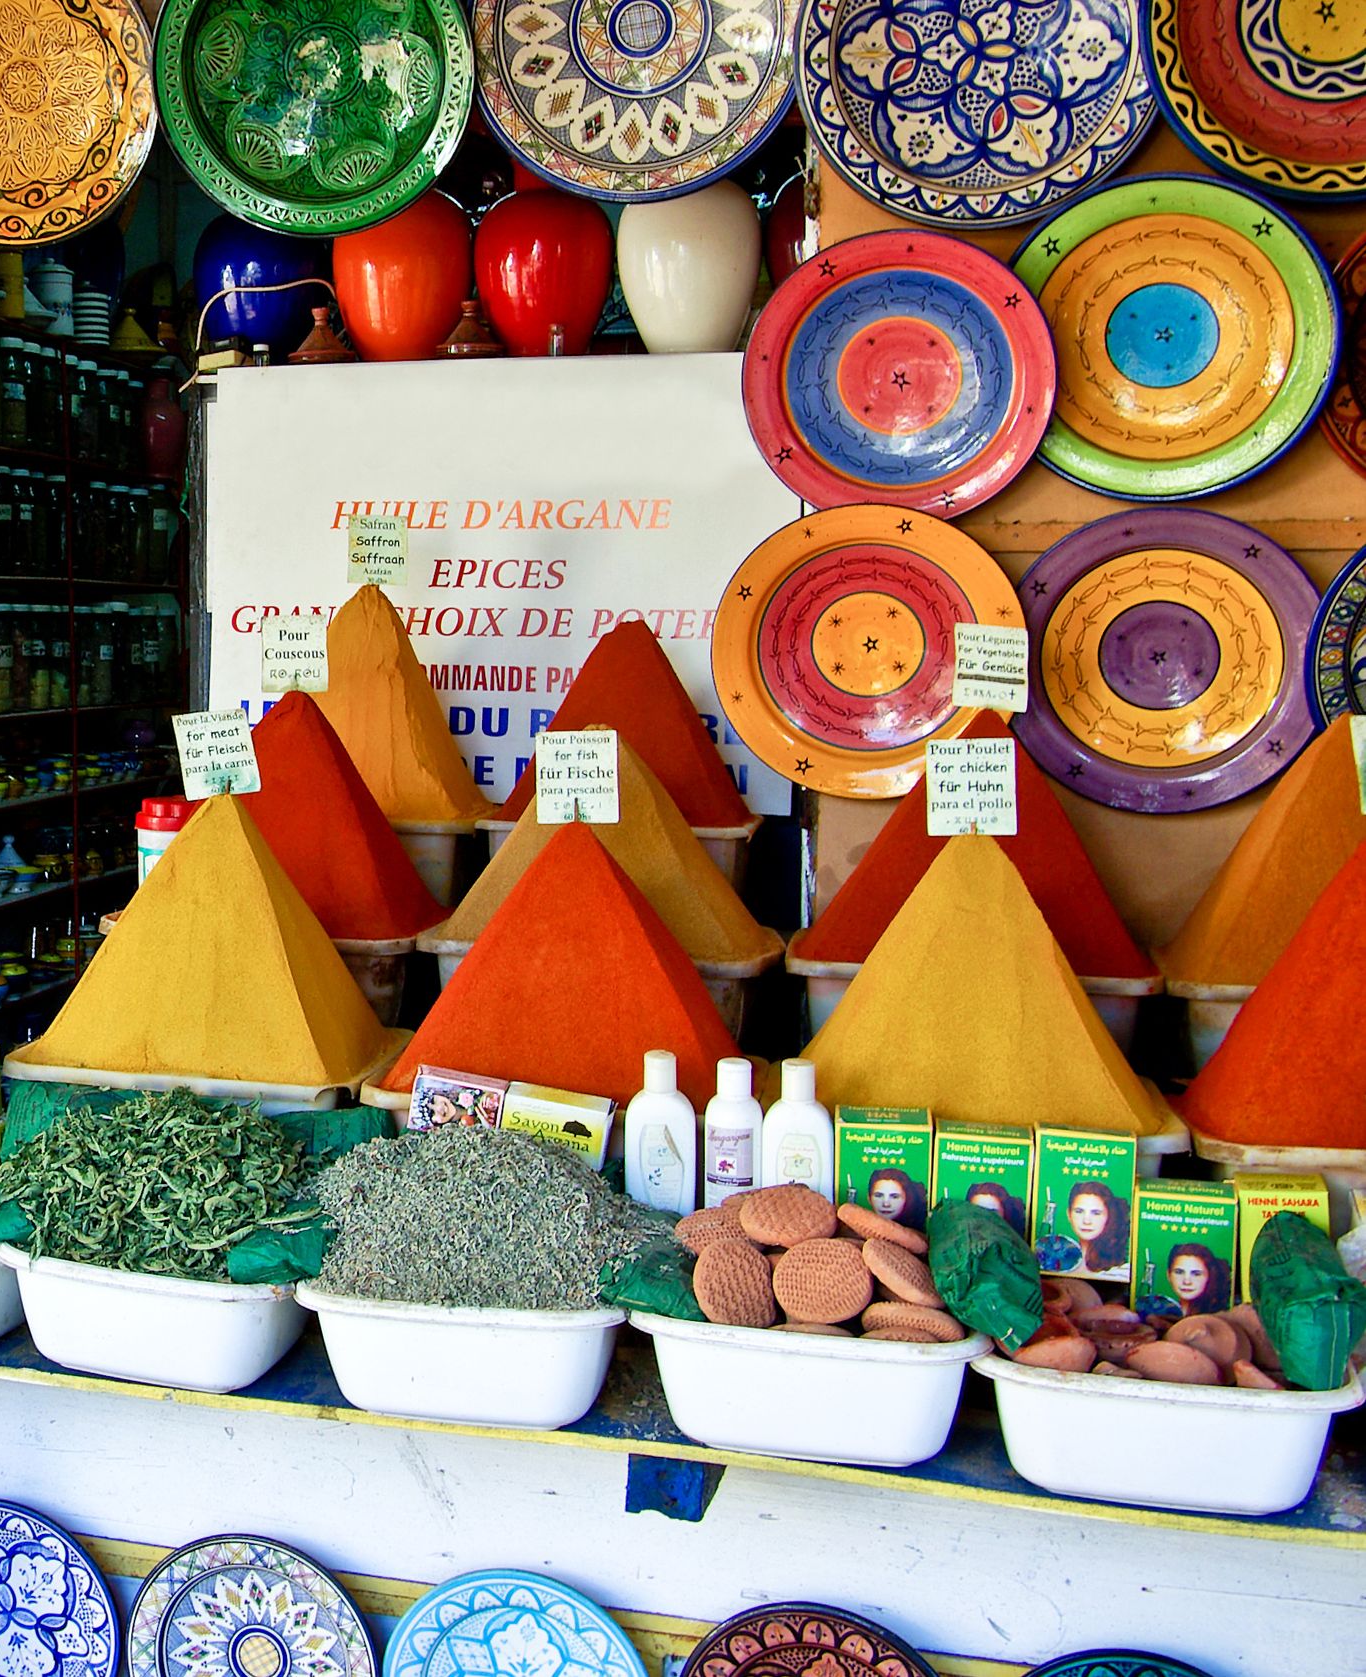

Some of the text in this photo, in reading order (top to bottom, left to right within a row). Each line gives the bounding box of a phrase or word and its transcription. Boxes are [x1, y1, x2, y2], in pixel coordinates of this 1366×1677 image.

[460, 498, 673, 530] D'ARGANE
[360, 518, 396, 530] Safran
[356, 536, 400, 547] Saffron
[351, 552, 405, 566] Saffraan
[428, 558, 568, 590] EPICES
[394, 606, 508, 637] HOIX
[517, 607, 573, 638] DE
[279, 629, 310, 641] Pour
[957, 631, 980, 642] Pour
[264, 648, 325, 660] Couscous
[958, 645, 1025, 659] For Vegetables
[958, 658, 1025, 675] Für Gemüse
[175, 711, 244, 727] Pour la Viande
[449, 706, 509, 737] DU
[187, 727, 240, 742] for meat
[542, 734, 610, 745] Pour Poisson
[185, 742, 248, 759] für Fleisch
[555, 750, 598, 761] for fish
[930, 743, 1010, 755] Pour Poulet
[185, 758, 254, 777] para la carne
[540, 766, 563, 780] für
[567, 766, 614, 779] Fische
[934, 761, 1007, 773] for chicken
[540, 785, 614, 797] para pescados
[939, 780, 1004, 793] für Huhn
[931, 798, 1012, 812] para el pollo
[510, 1111, 560, 1133] Savon
[946, 1141, 1020, 1156] Henné Naturel
[1146, 1200, 1225, 1216] Henné Naturel
[1248, 1196, 1319, 1207] HENNÉ SAHARA
